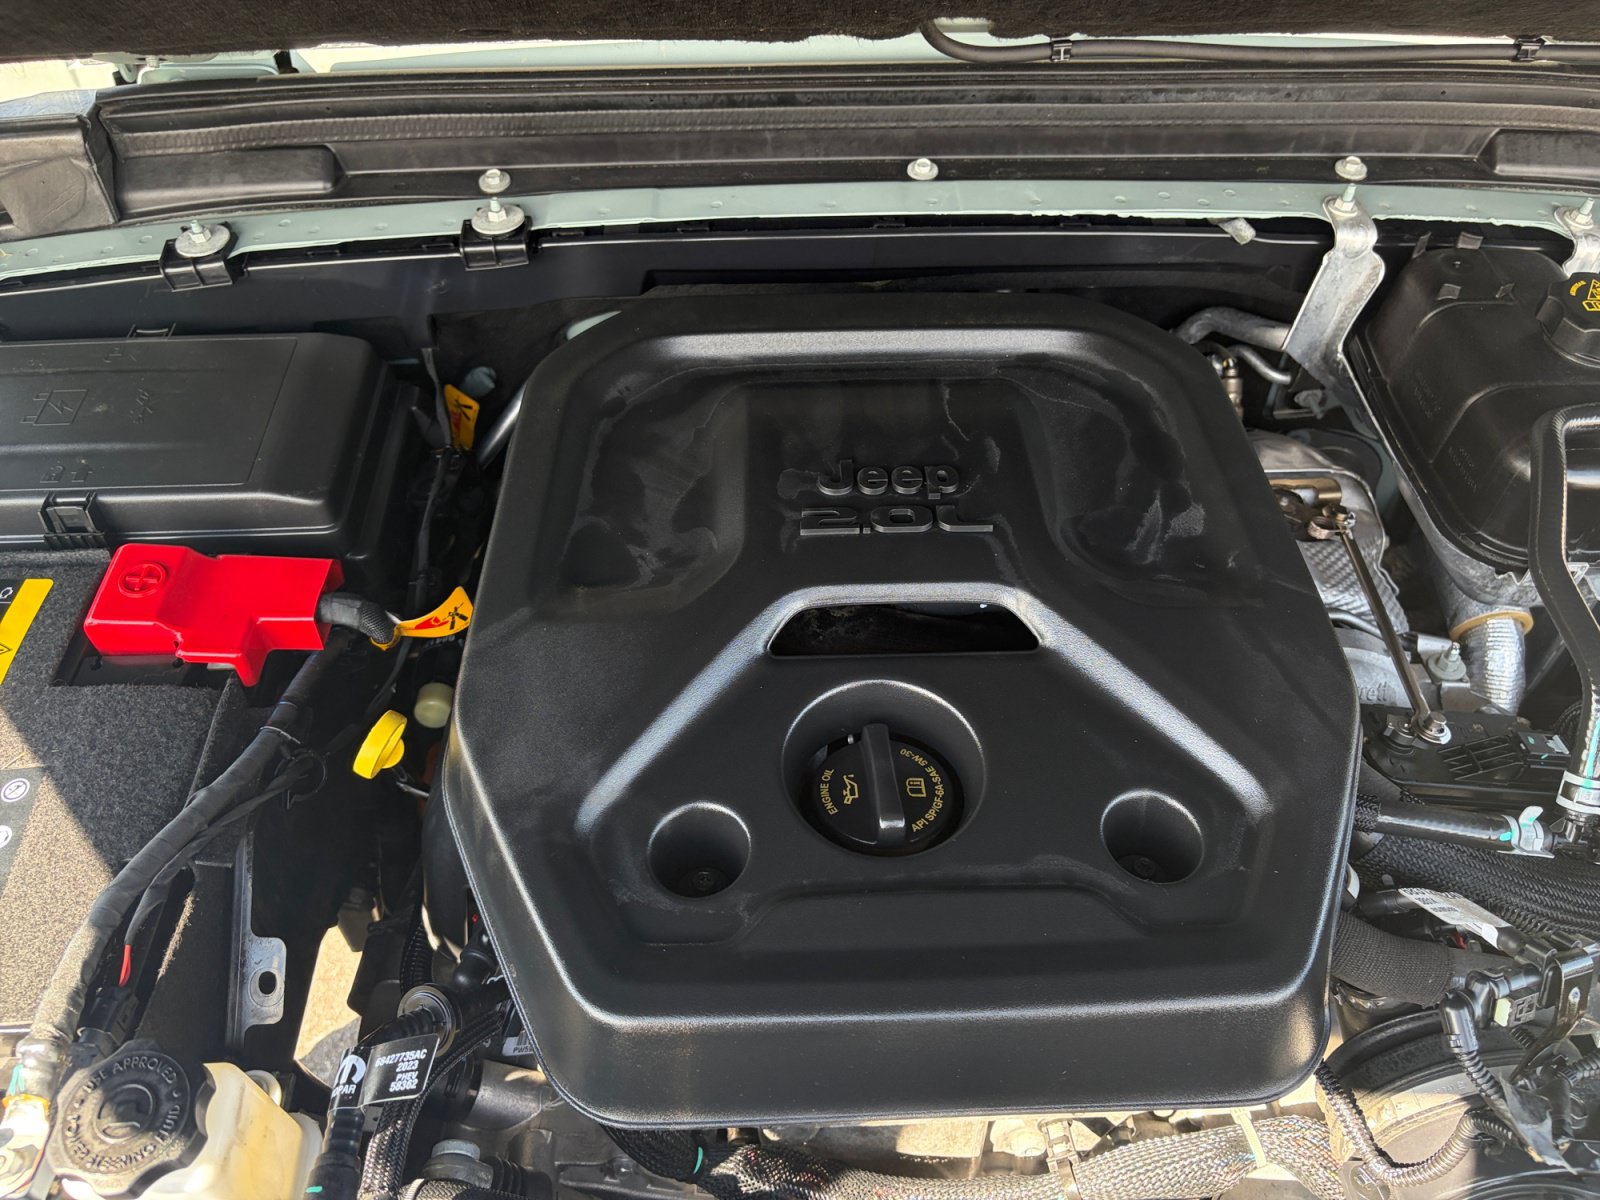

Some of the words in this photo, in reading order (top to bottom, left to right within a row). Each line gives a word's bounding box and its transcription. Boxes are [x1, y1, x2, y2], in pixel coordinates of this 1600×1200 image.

[816, 459, 959, 500] Jeep
[800, 504, 994, 536] 2.0L
[1358, 681, 1388, 702] rett
[900, 748, 928, 767] 5W-30
[822, 768, 835, 781] OIL
[820, 783, 838, 815] ENGINE
[911, 818, 928, 832] API
[112, 1056, 177, 1084] APPROVED
[395, 1061, 419, 1073] 2023
[395, 1070, 419, 1082] PHEV
[332, 1083, 357, 1098] OPAR
